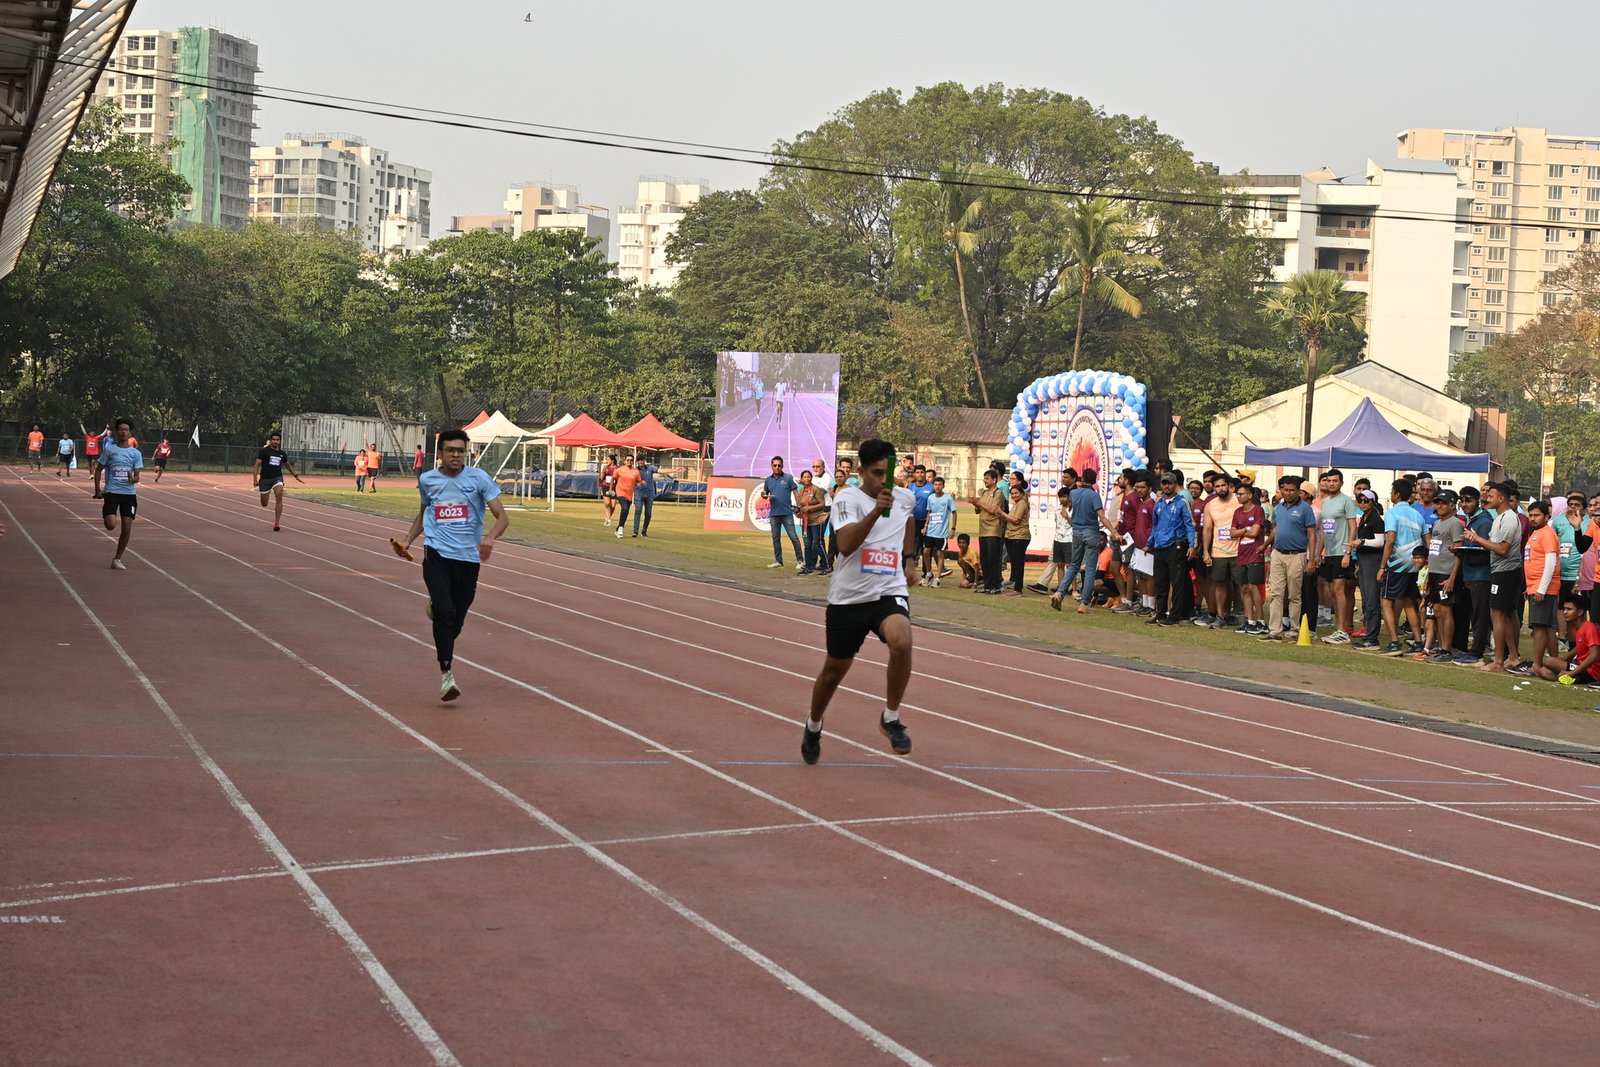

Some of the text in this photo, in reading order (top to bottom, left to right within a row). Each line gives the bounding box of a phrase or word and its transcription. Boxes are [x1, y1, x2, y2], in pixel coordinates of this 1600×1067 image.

[713, 498, 743, 509] RISERS
[439, 508, 463, 517] 6023
[868, 552, 895, 565] 7052
[1492, 585, 1497, 593] 3
